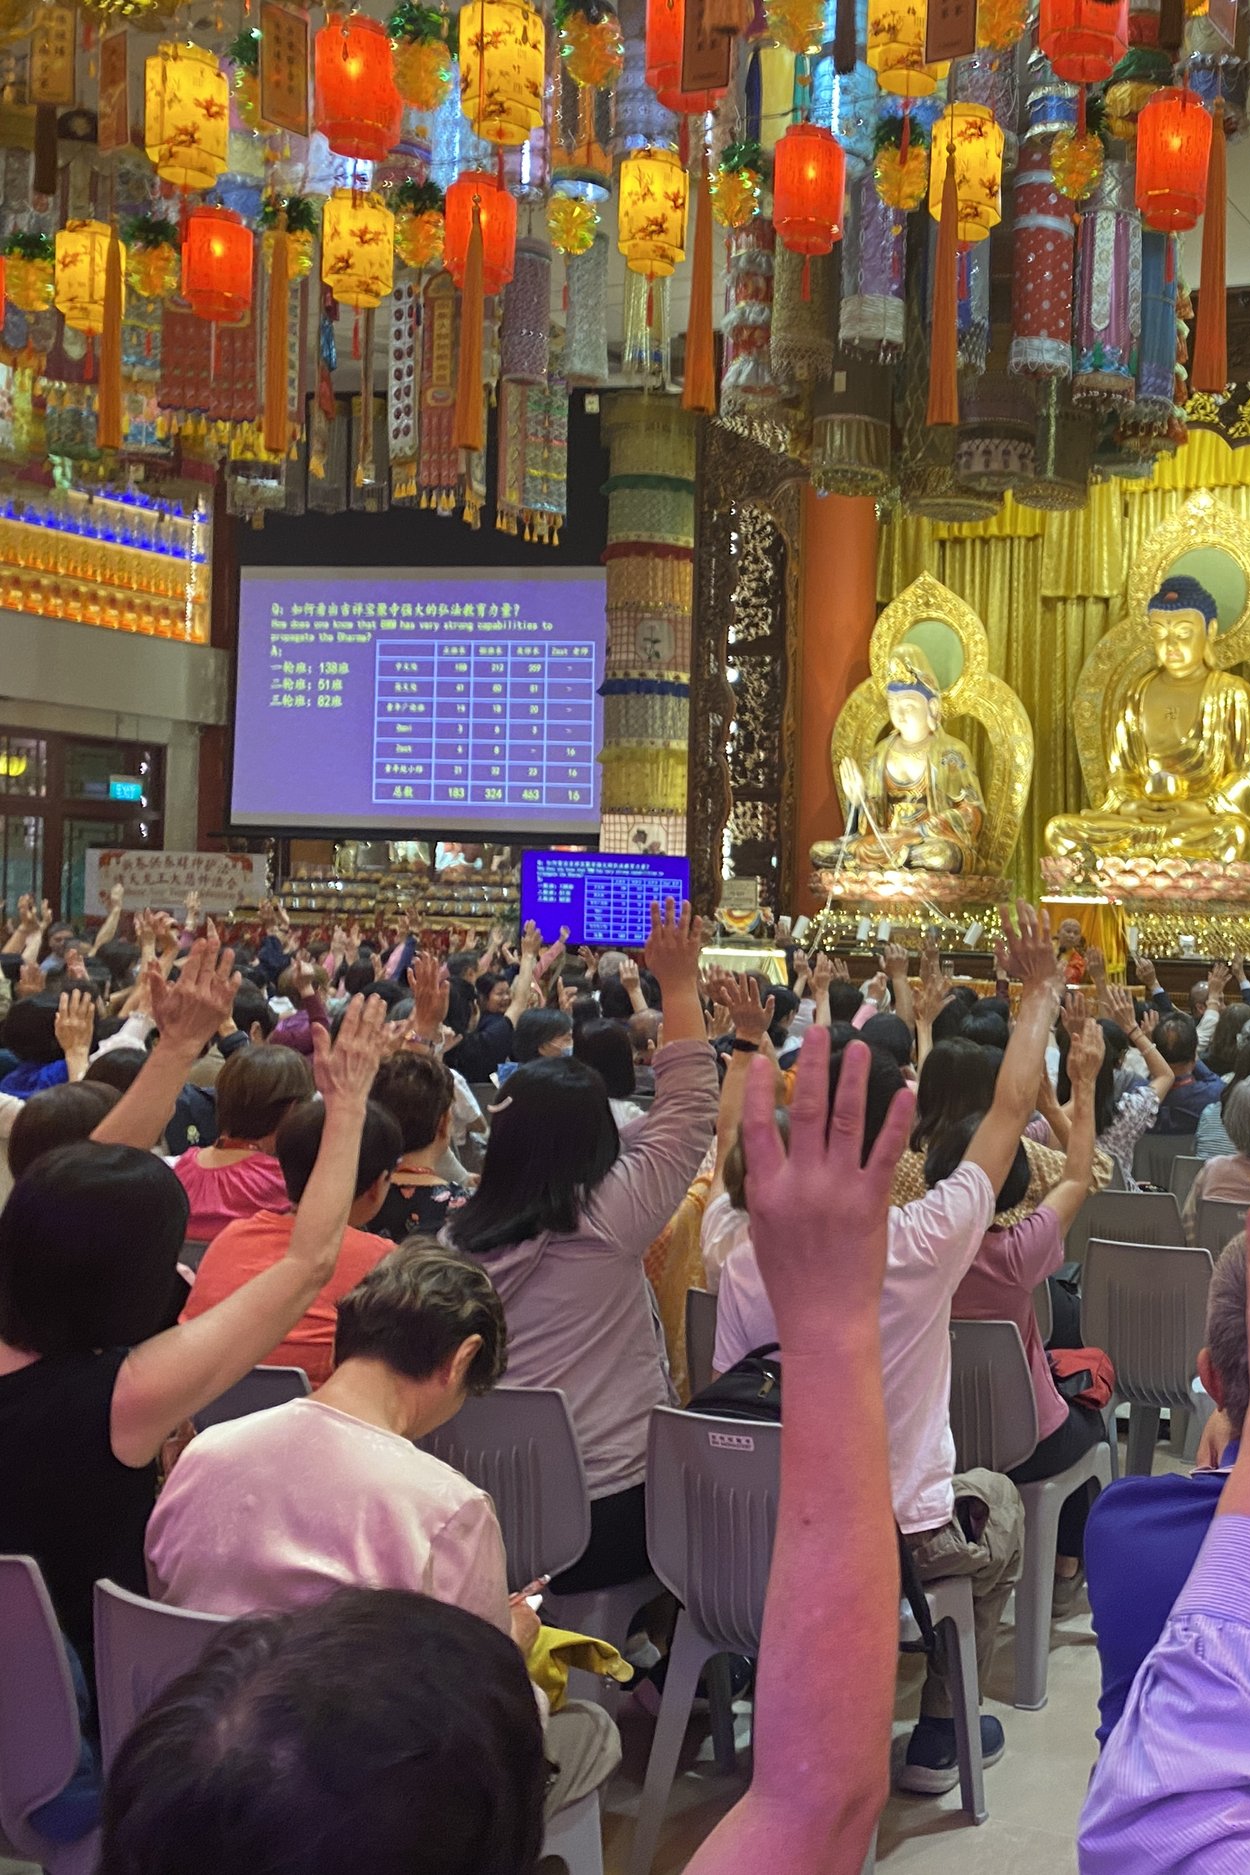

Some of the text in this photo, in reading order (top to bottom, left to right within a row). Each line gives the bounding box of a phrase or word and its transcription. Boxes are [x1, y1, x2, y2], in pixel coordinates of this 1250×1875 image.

[400, 621, 415, 630] has
[420, 622, 439, 631] very
[444, 621, 473, 631] strong
[478, 621, 537, 631] capabilities
[543, 622, 553, 630] to
[567, 748, 575, 756] 16
[569, 769, 577, 777] 16
[449, 788, 464, 798] 183
[485, 789, 502, 799] 324
[522, 790, 539, 800] 463
[569, 791, 580, 801] 16
